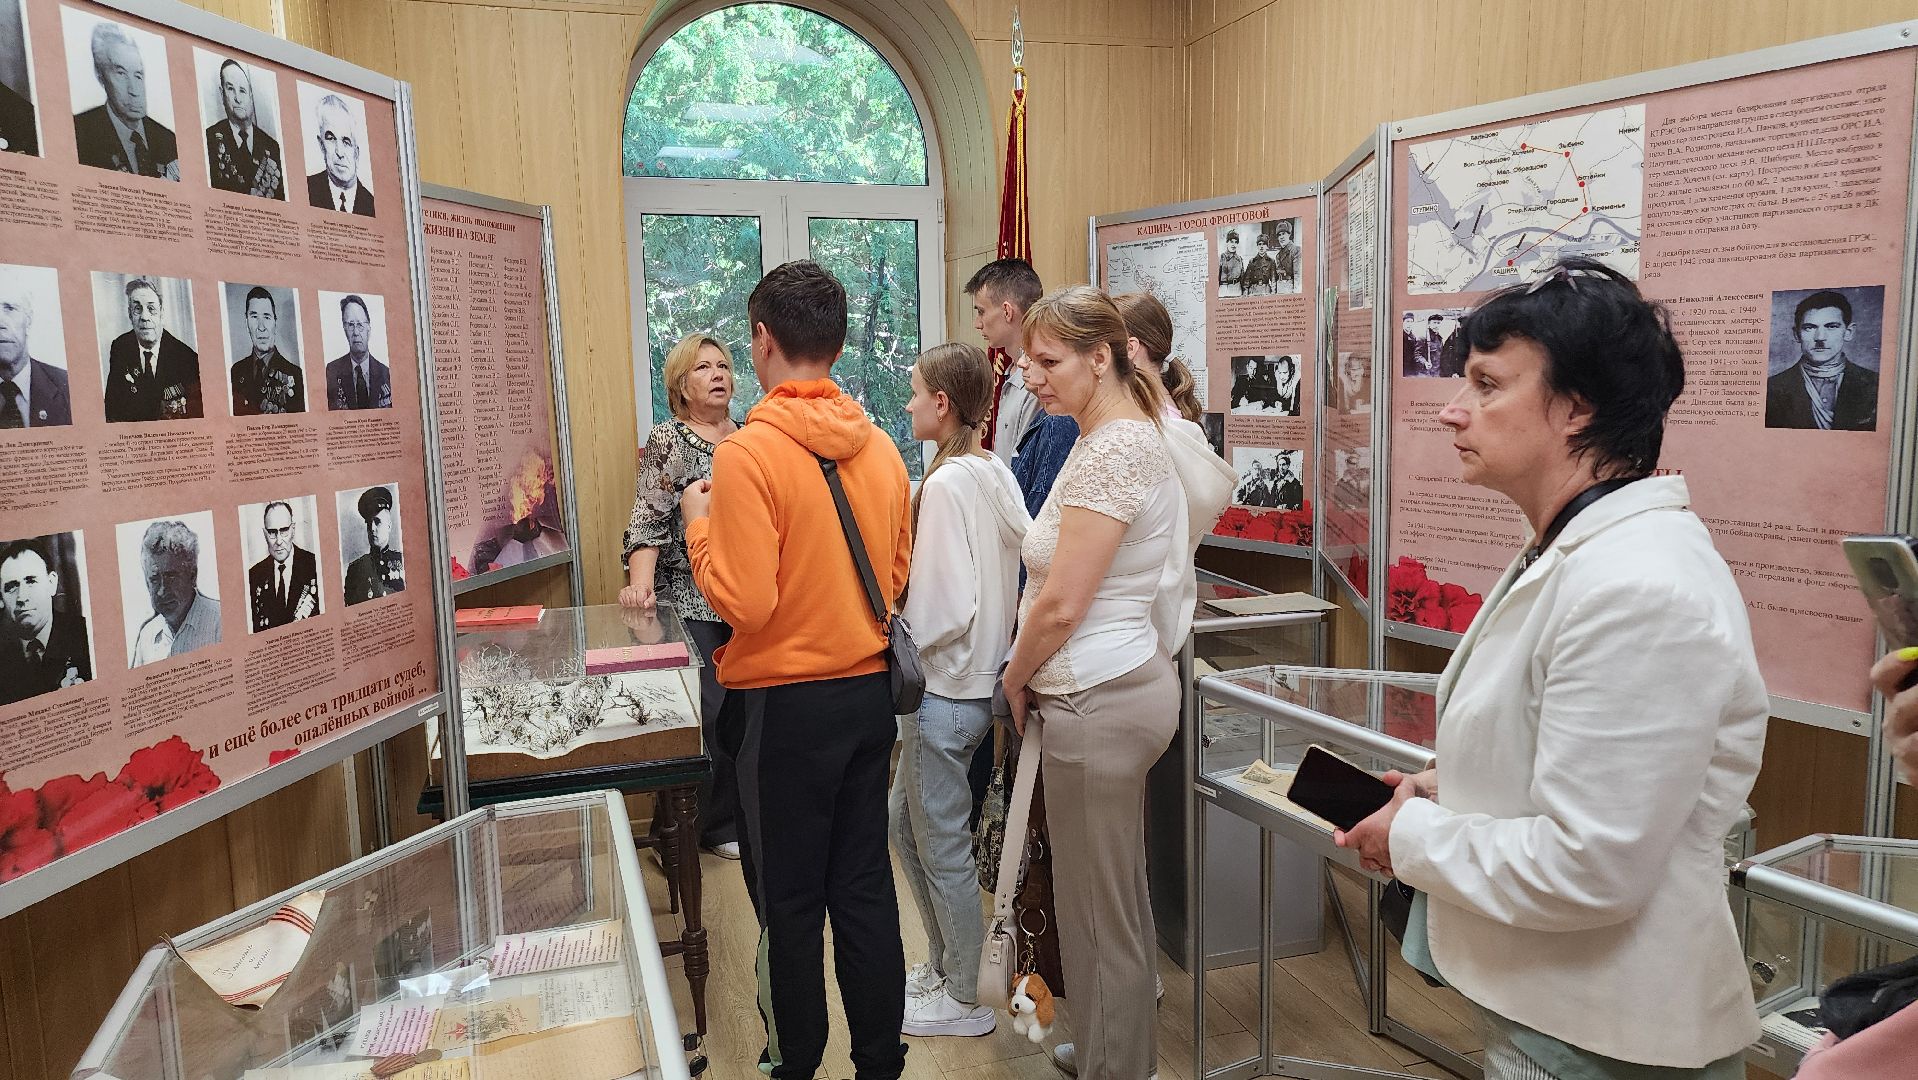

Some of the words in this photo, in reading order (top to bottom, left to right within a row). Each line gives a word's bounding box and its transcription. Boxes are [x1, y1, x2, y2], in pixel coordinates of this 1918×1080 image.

[1840, 121, 1861, 130] ОРС
[1412, 204, 1438, 214] СТУПИНО
[1210, 208, 1270, 225] ФРОНТОВОЙ
[424, 223, 455, 238] ЖИЗНИ
[456, 228, 468, 240] НА
[470, 230, 496, 244] ЗЕМЛЕ
[1716, 291, 1763, 301] Алексеевич
[1739, 305, 1756, 313] 1940
[1688, 327, 1719, 336] финской
[1733, 568, 1756, 578] ГРЭС
[208, 744, 219, 759] и
[224, 726, 256, 752] ещё
[260, 712, 302, 738] более
[305, 702, 328, 720] ста
[331, 677, 390, 712] тридцати
[394, 660, 426, 688] судеб,
[294, 705, 370, 746] опалённых
[374, 684, 414, 713] войной
